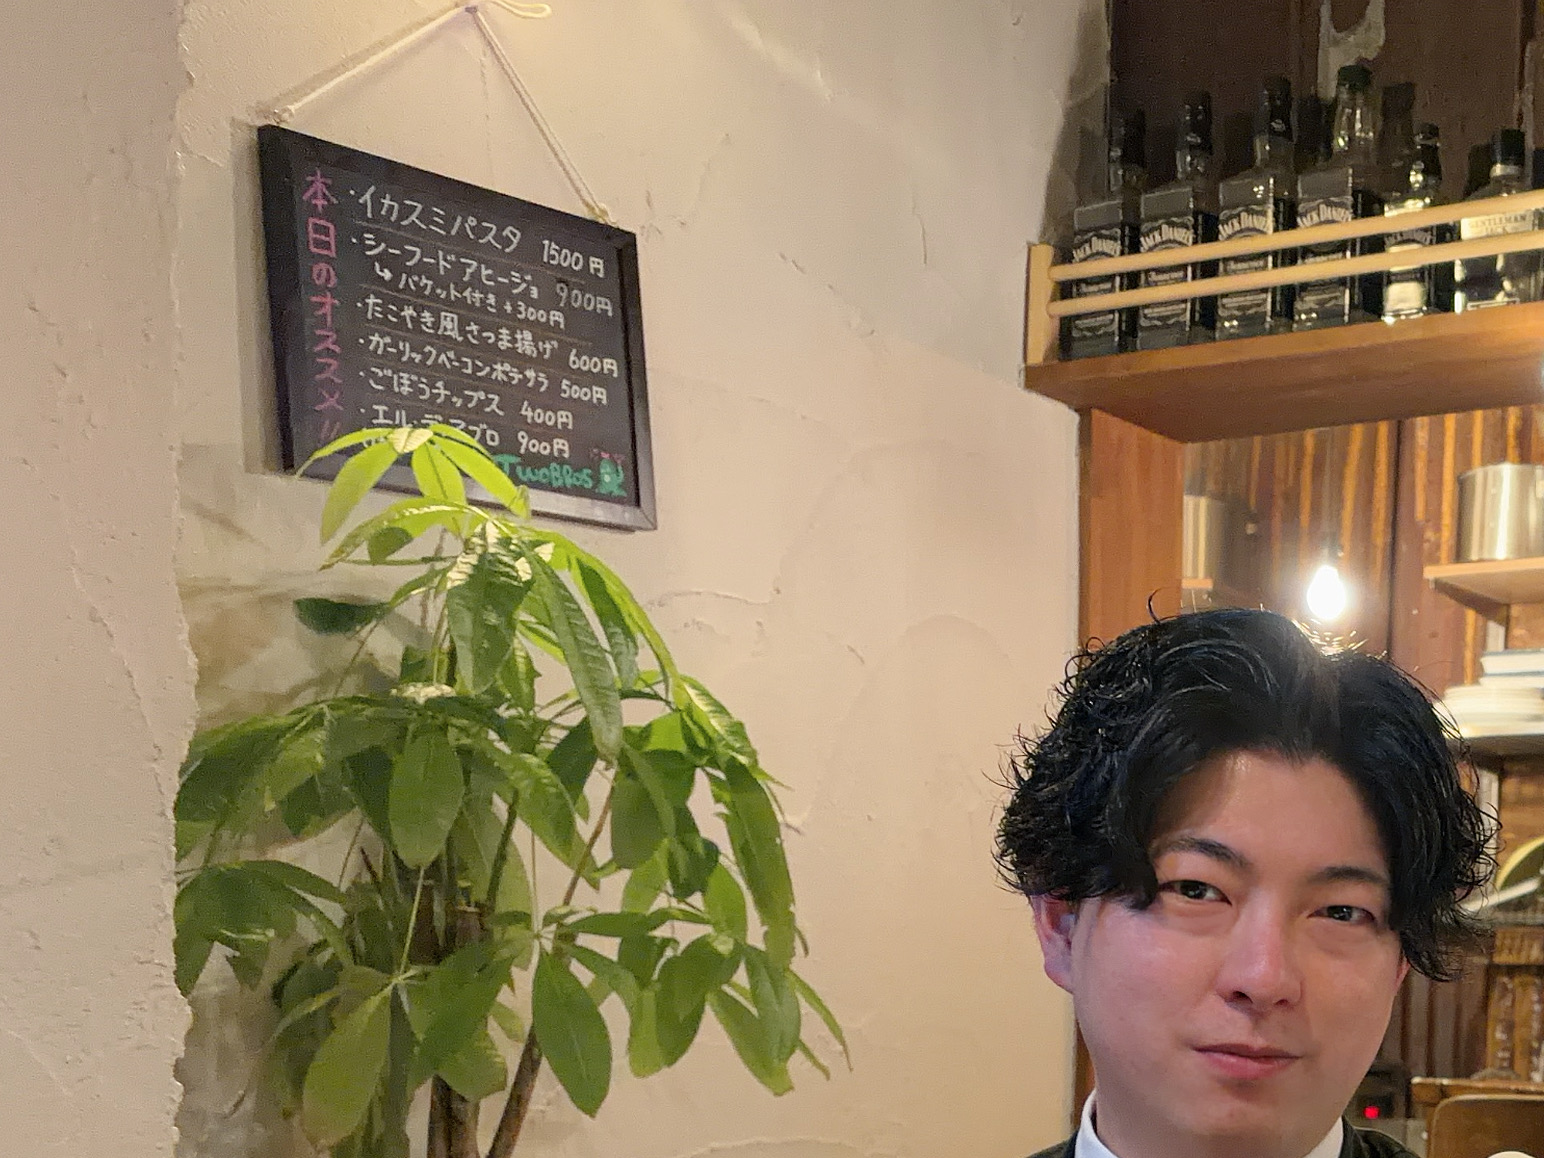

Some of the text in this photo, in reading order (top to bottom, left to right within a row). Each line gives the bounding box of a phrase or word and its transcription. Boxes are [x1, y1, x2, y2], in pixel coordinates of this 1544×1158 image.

[358, 185, 521, 253] イカスミパスタ
[556, 283, 613, 317] 900円
[568, 348, 619, 379] 600円
[368, 366, 574, 430] ごぼうチップス 400円
[560, 378, 608, 405] 500円
[517, 430, 570, 458] 900円
